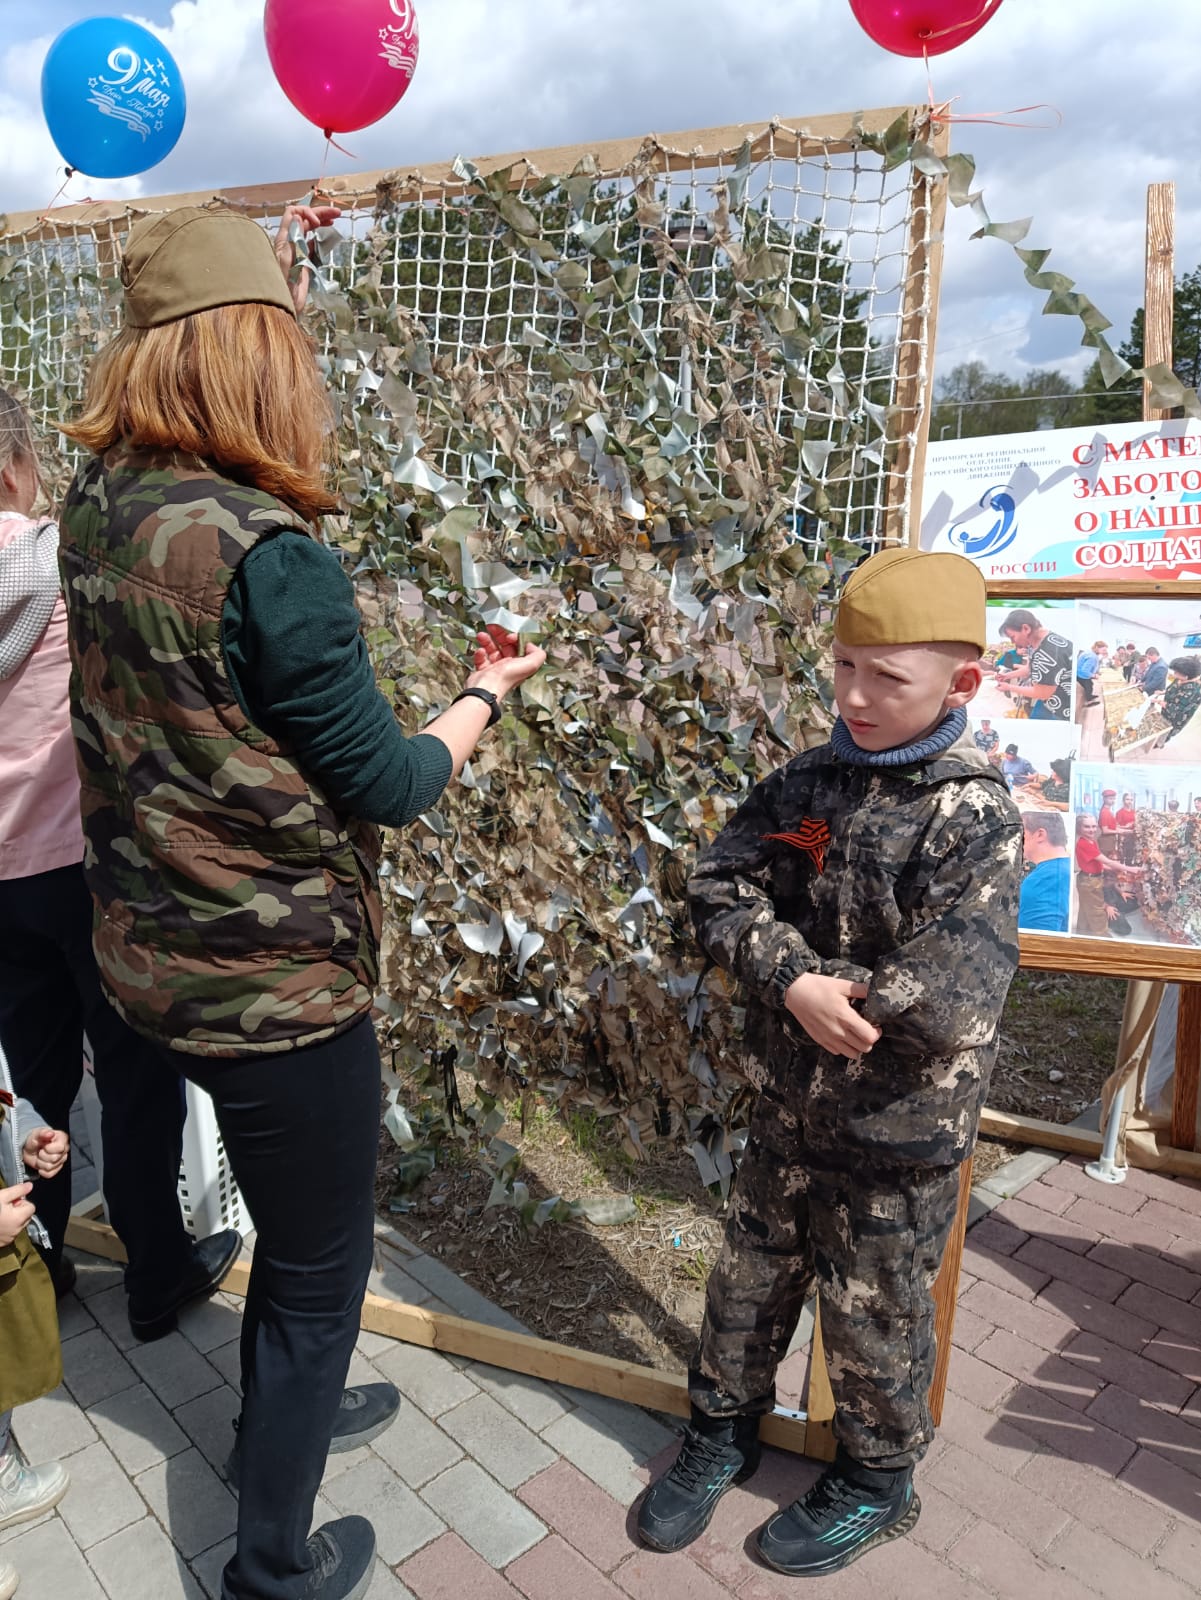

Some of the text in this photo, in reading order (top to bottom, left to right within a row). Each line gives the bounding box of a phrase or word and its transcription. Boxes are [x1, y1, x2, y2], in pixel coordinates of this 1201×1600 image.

[98, 46, 170, 108] 9 Мая
[1072, 435, 1201, 465] С МАТЕ
[1073, 470, 1201, 499] ЗАБОТО
[1074, 504, 1201, 532] О НАШ
[990, 561, 1057, 576] РОССИИ
